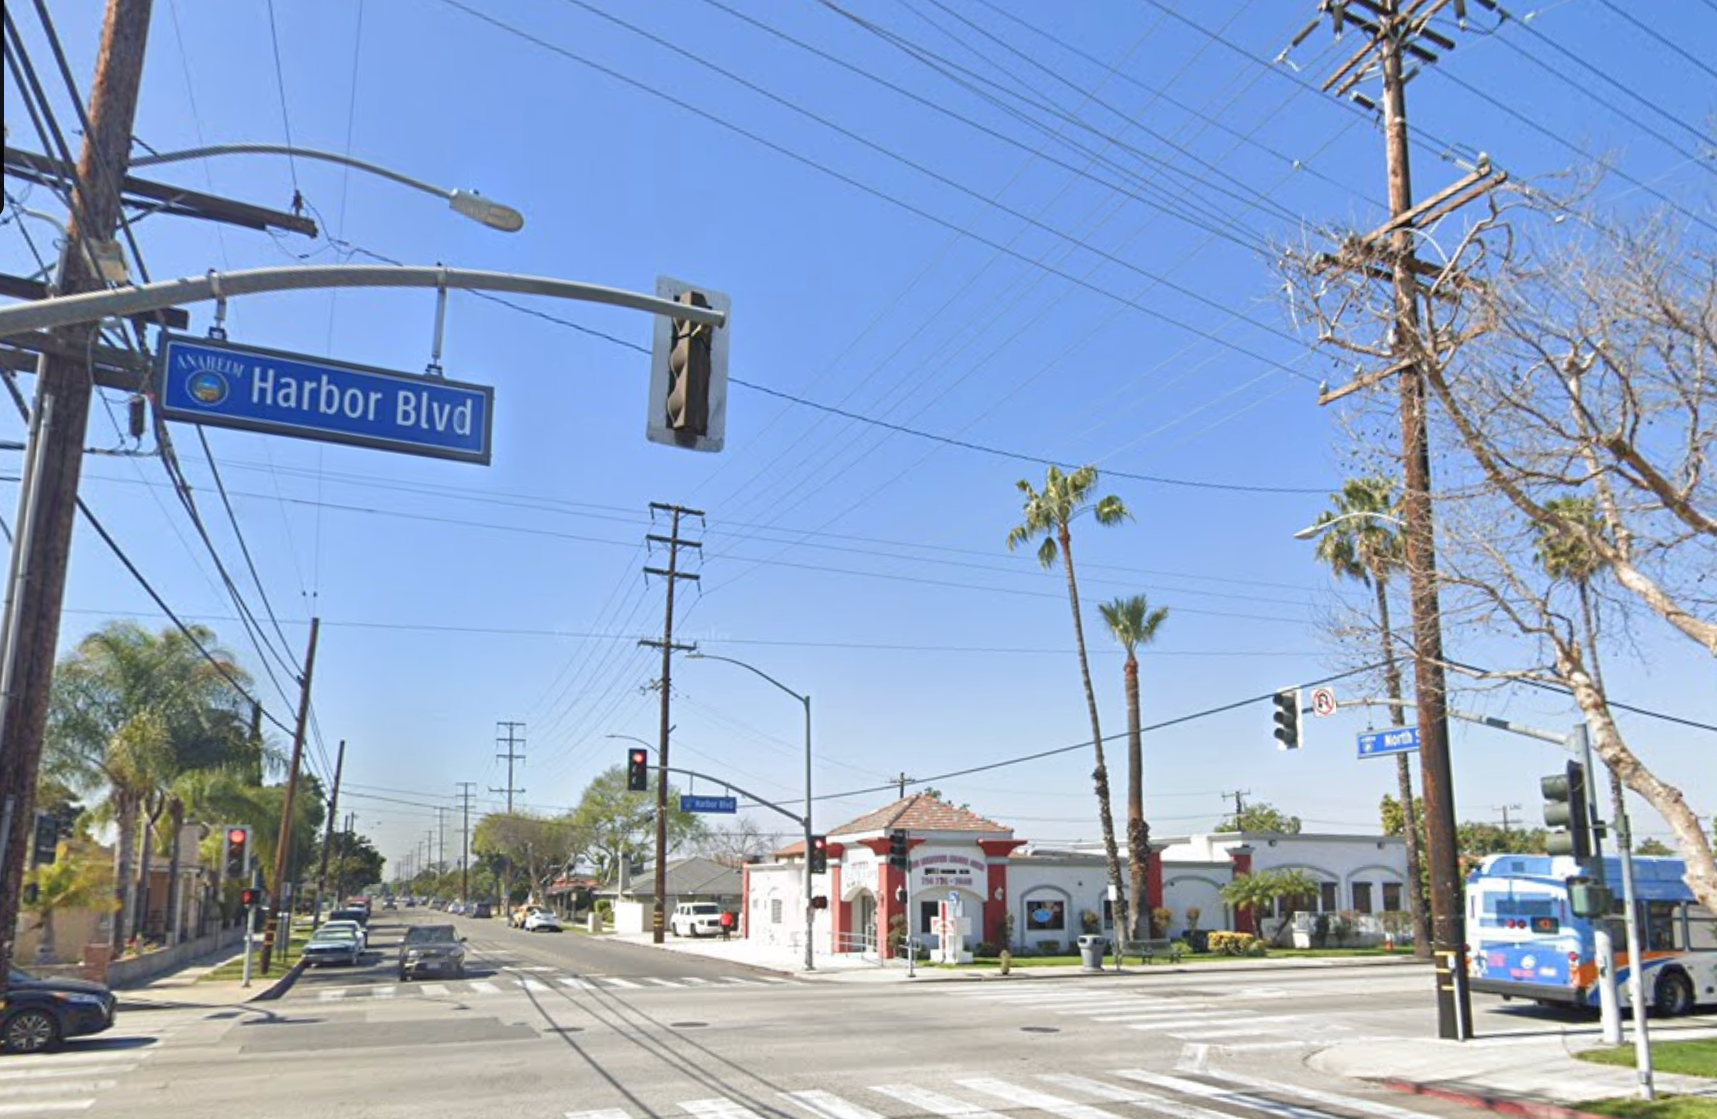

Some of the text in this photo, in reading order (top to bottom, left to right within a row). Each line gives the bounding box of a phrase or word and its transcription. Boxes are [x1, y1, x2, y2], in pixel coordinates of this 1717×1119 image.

[177, 354, 246, 379] ANAHEIM
[251, 367, 473, 436] Harbor Blvd
[1384, 730, 1413, 747] North
[695, 799, 734, 810] Harbor Blvd
